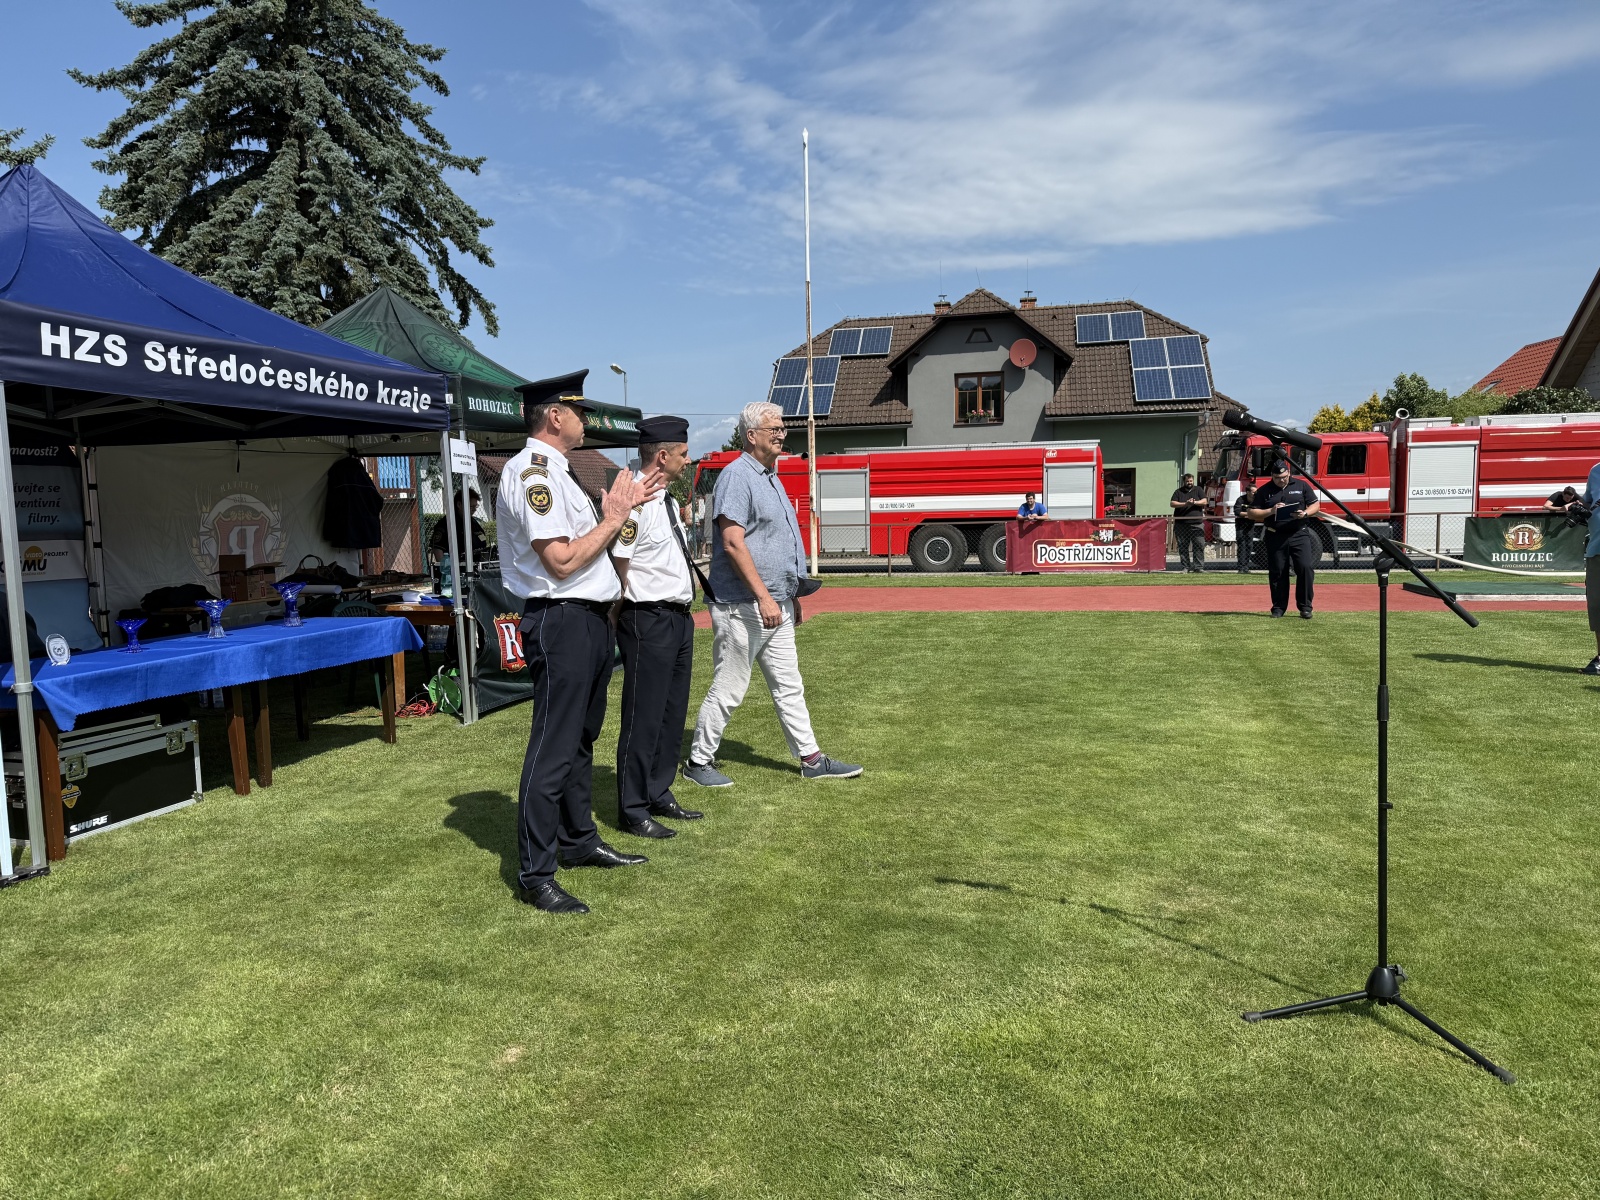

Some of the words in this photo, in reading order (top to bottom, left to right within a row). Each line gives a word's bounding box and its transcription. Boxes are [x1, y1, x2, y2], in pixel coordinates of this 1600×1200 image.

[40, 321, 129, 368] HZS
[143, 340, 369, 401] Středočeského
[376, 379, 432, 413] kraje
[467, 396, 514, 415] ROHOZEC
[47, 485, 61, 493] se
[27, 512, 60, 525] filmy.
[1516, 531, 1531, 545] R
[1039, 541, 1131, 562] POSTŘIŽINSKÉ
[1491, 552, 1553, 562] ROHOZEC
[499, 622, 525, 661] R
[69, 814, 109, 834] SHURE
